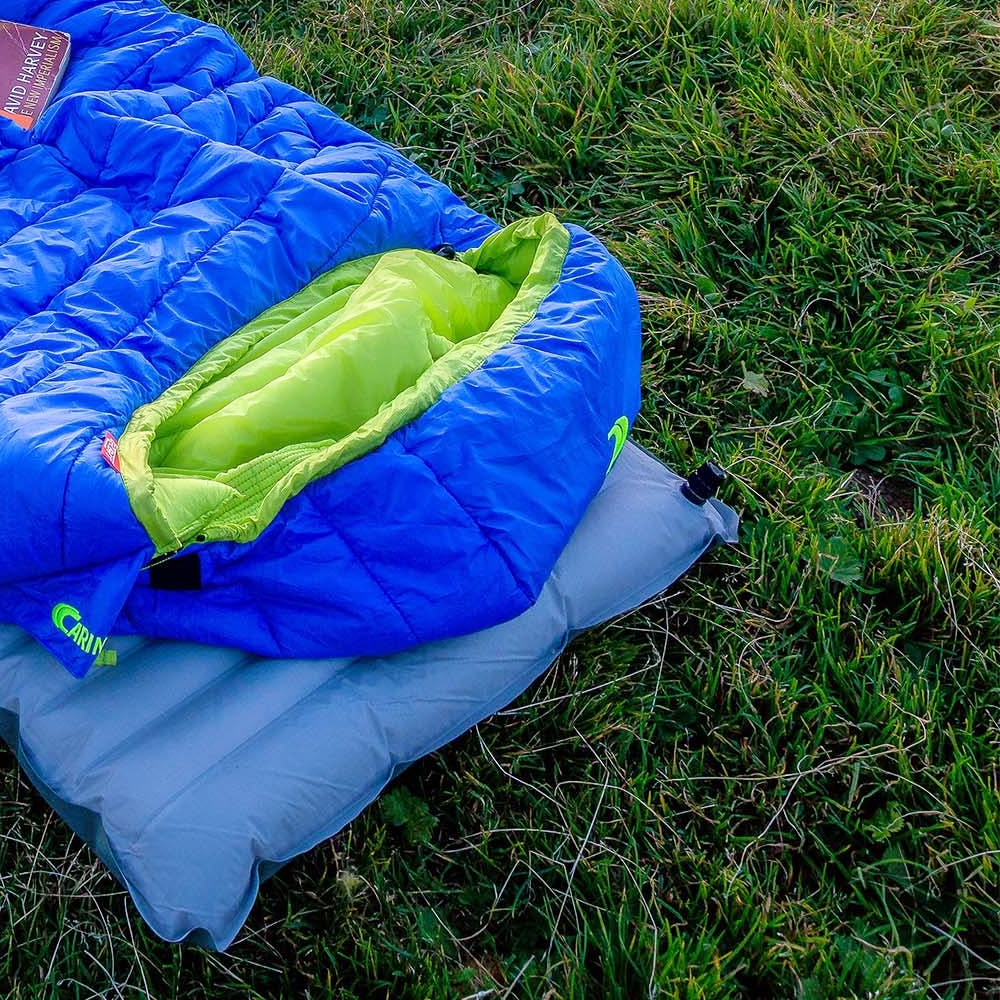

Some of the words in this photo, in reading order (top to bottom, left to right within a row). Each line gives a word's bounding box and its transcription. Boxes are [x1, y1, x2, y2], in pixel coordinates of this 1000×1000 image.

[3, 85, 27, 114] AVID
[16, 32, 48, 83] HARVEY
[22, 89, 42, 110] NEW
[32, 33, 62, 91] IMPERIALISM
[52, 602, 108, 655] CARIN
